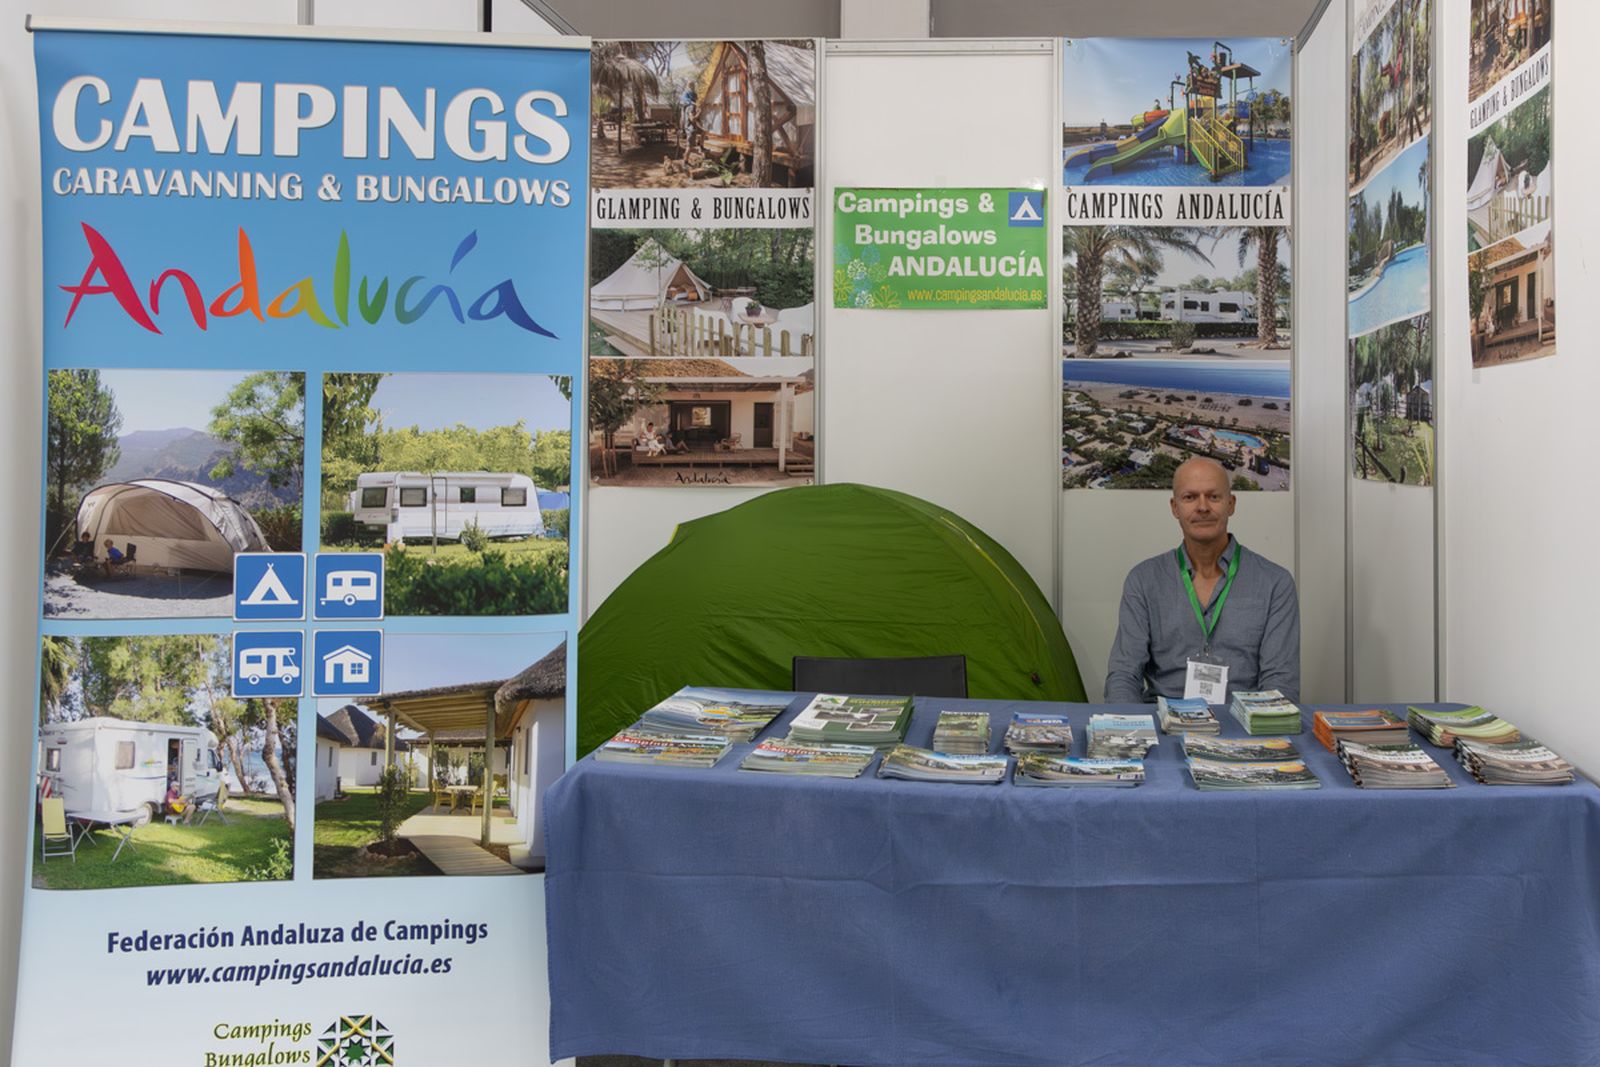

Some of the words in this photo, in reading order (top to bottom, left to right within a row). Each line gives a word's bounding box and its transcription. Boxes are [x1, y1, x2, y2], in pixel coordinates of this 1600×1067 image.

[52, 75, 571, 164] CAMPINGS
[52, 167, 303, 200] CARAVANNING
[317, 174, 342, 202] &
[356, 175, 571, 207] BUNGALOWS
[597, 197, 680, 220] GLAMPING
[691, 198, 702, 219] &
[713, 196, 810, 220] BUNGALOWS
[838, 192, 969, 218] Campings
[977, 193, 994, 213] &
[1067, 192, 1163, 220] CAMPINGS
[1176, 190, 1283, 220] ANDALUCÍA
[855, 225, 997, 251] Bungalows
[888, 250, 1044, 277] ANDALUCÍA
[58, 221, 560, 340] Andalucía
[907, 286, 1043, 304] www.campingsandalucia.es
[107, 926, 234, 953] Federación
[240, 923, 344, 947] Andaluza
[351, 921, 377, 942] de
[383, 919, 489, 947] Campings
[146, 954, 453, 986] www.campingsandalucia.es
[213, 1019, 312, 1045] Campings
[204, 1042, 311, 1067] Bungalows
